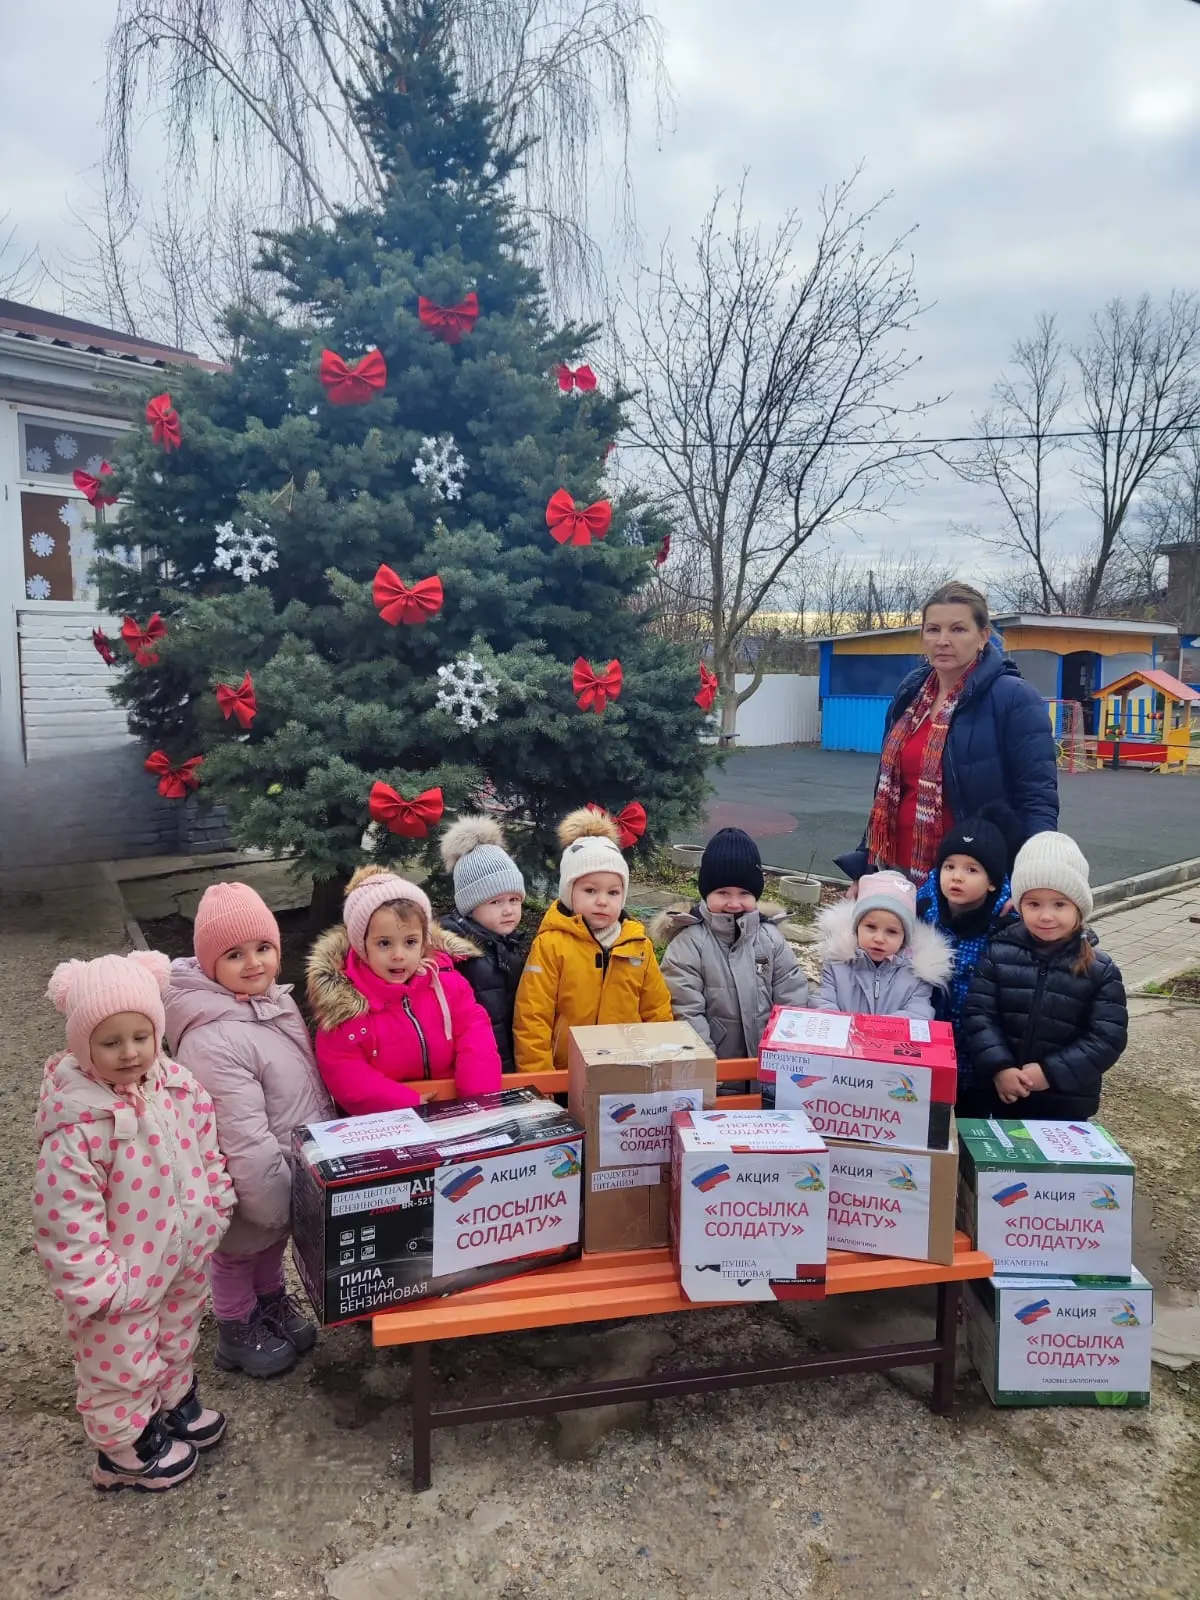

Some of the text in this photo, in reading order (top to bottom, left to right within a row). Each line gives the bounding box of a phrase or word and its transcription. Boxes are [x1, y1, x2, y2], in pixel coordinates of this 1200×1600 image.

[763, 1051, 810, 1064] ПРОДУКТЫ
[762, 1062, 804, 1073] ПИТАНИЯ
[832, 1075, 874, 1089] АКЦИЯ
[640, 1106, 668, 1116] АКЦИЯ
[802, 1099, 902, 1125] «ПОСЫЛКА
[620, 1125, 673, 1138] «ПОСЫЛ
[808, 1115, 896, 1140] ОЛДАТУ»
[620, 1138, 673, 1152] СОЛДАТ
[490, 1164, 537, 1184] АКЦИЯ
[593, 1168, 639, 1182] ПРОДУКТЫ
[736, 1173, 779, 1184] АКЦИЯ
[832, 1164, 873, 1178] АКЦИЯ
[593, 1179, 634, 1191] ПИТАНИЯ
[333, 1193, 361, 1203] ПИЛА
[828, 1191, 902, 1214] ОСЫЛКА
[1034, 1190, 1076, 1201] АКЦИЯ
[333, 1197, 397, 1214] БЕНЗИНОВАЯ
[455, 1190, 567, 1225] «ПОСЫЛКА
[704, 1202, 809, 1217] «ПОСЫЛКА
[828, 1208, 897, 1229] ЛДАТУ»
[1005, 1216, 1105, 1234] «ПОСЫЛКА
[456, 1215, 563, 1250] СОЛДАТУ»
[705, 1222, 804, 1239] СОЛДАТУ»
[1005, 1233, 1100, 1251] СОЛДАТУ»
[722, 1260, 757, 1268] ПУШКА
[993, 1258, 1049, 1267] ДИКАМЕНТЫ
[340, 1268, 382, 1287] ПИЛА
[722, 1270, 772, 1279] ТЕПЛОВАЯ
[340, 1277, 395, 1301] ЦЕПНАЯ
[340, 1281, 428, 1314] БЕНЗИНОВАЯ
[1056, 1307, 1097, 1320] АКЦИЯ
[1026, 1333, 1125, 1349] «ПОСЫЛКА
[1026, 1350, 1120, 1369] СОЛДАТУ»
